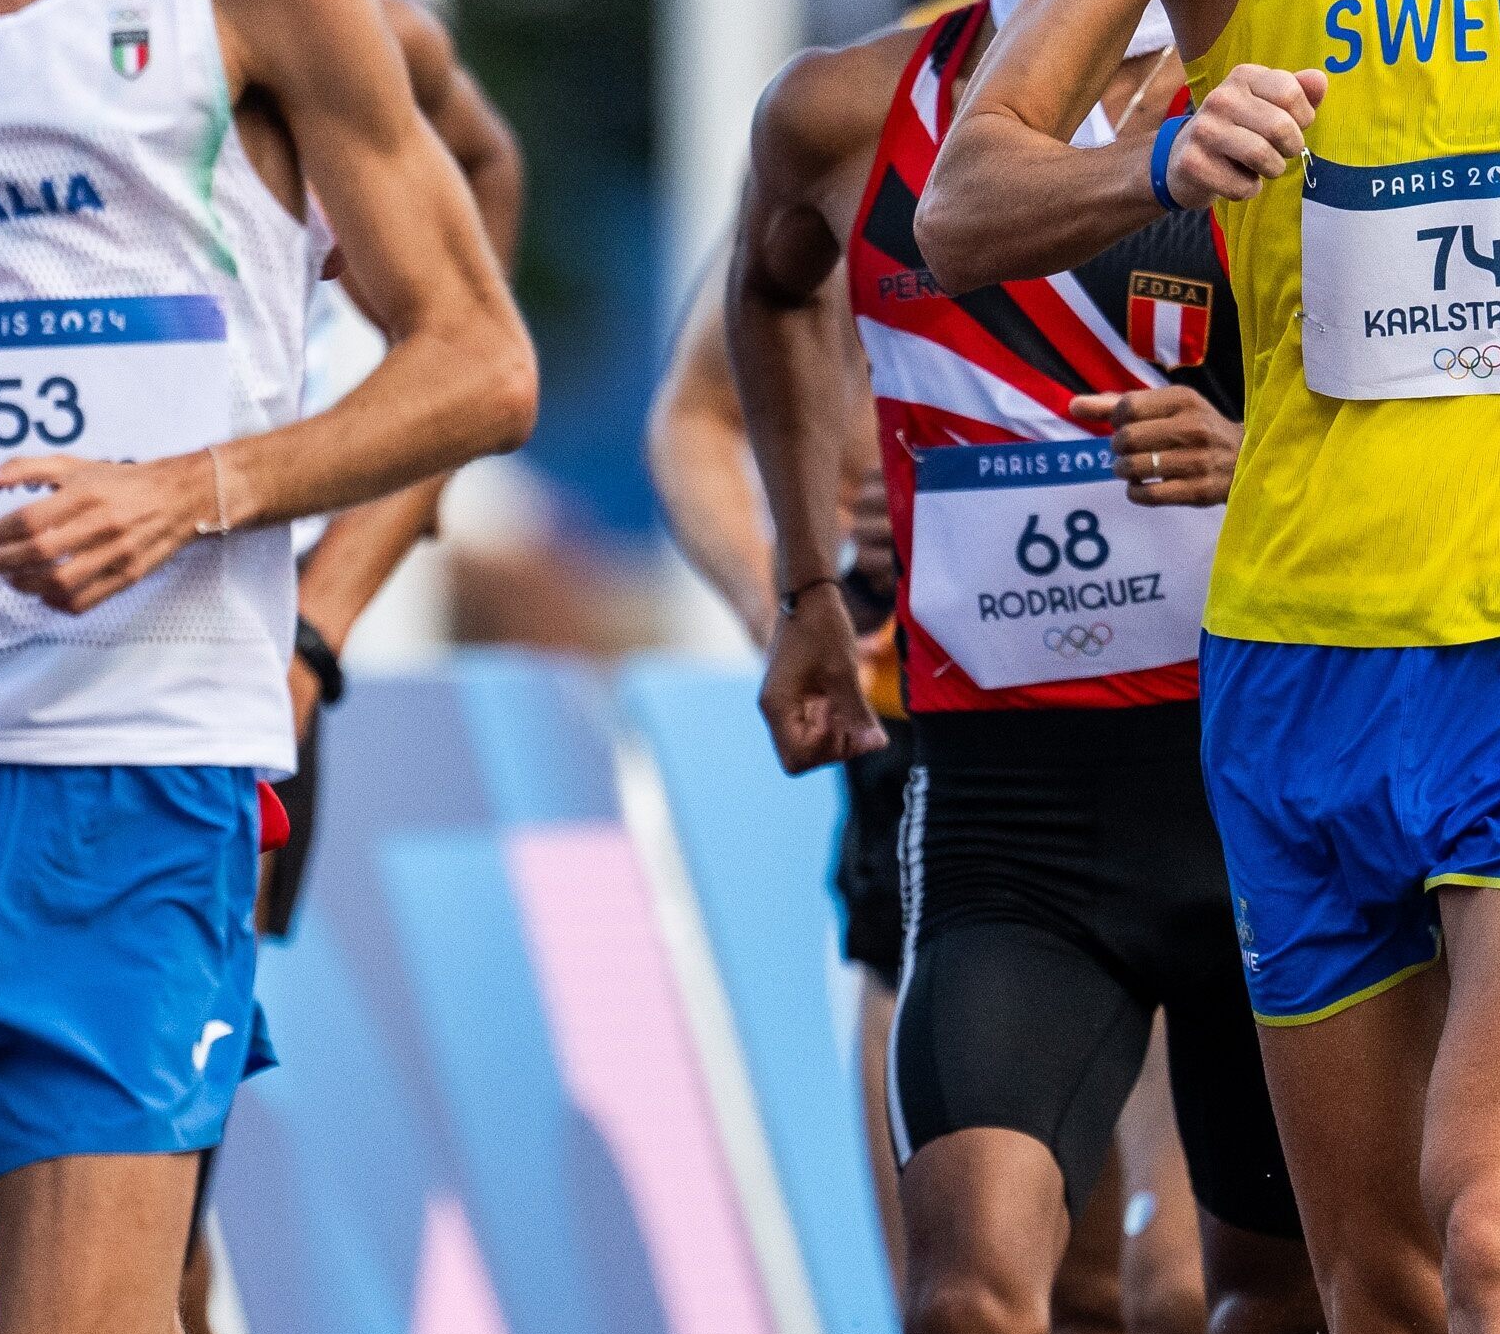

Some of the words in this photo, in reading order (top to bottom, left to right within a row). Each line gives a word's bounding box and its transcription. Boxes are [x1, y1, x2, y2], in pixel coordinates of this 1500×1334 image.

[1371, 169, 1457, 199] PARIS
[878, 270, 942, 301] PER
[40, 308, 128, 336] 2024
[978, 452, 1051, 478] PARIS
[1056, 448, 1113, 474] 202
[1015, 509, 1111, 577] 68
[977, 572, 1166, 623] RODRIGUEZ
